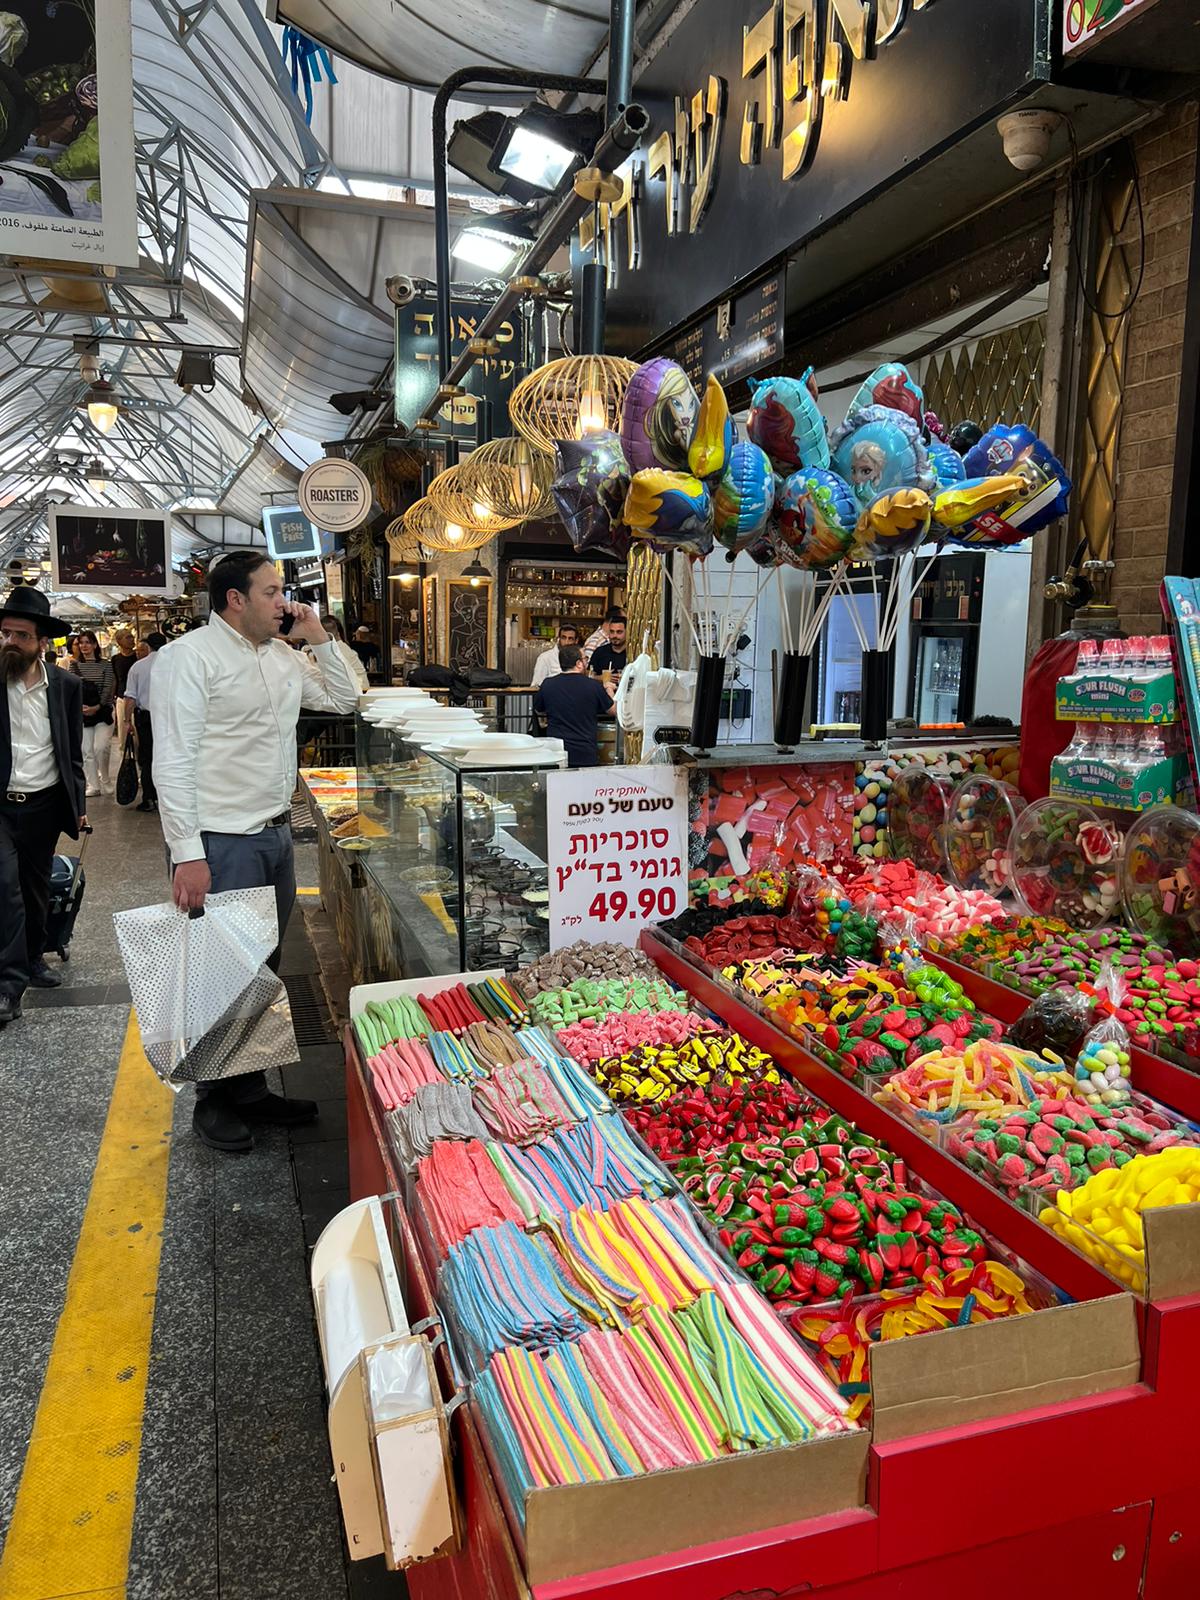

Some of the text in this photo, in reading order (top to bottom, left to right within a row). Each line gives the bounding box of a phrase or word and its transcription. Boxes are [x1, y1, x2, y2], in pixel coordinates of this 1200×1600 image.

[740, 0, 932, 181] אפה
[414, 313, 514, 342] כאה
[310, 489, 359, 502] ROASTERS
[280, 522, 303, 533] FISH
[1090, 692, 1110, 701] mini
[1098, 681, 1127, 697] FLUSH
[1082, 776, 1100, 785] mini
[1090, 766, 1116, 783] FLUSH
[595, 786, 648, 798] ממתקי דודו
[568, 797, 674, 816] טעם של פעם
[568, 828, 669, 855] סוכריות
[630, 857, 681, 880] גומי
[588, 886, 676, 922] 49.90
